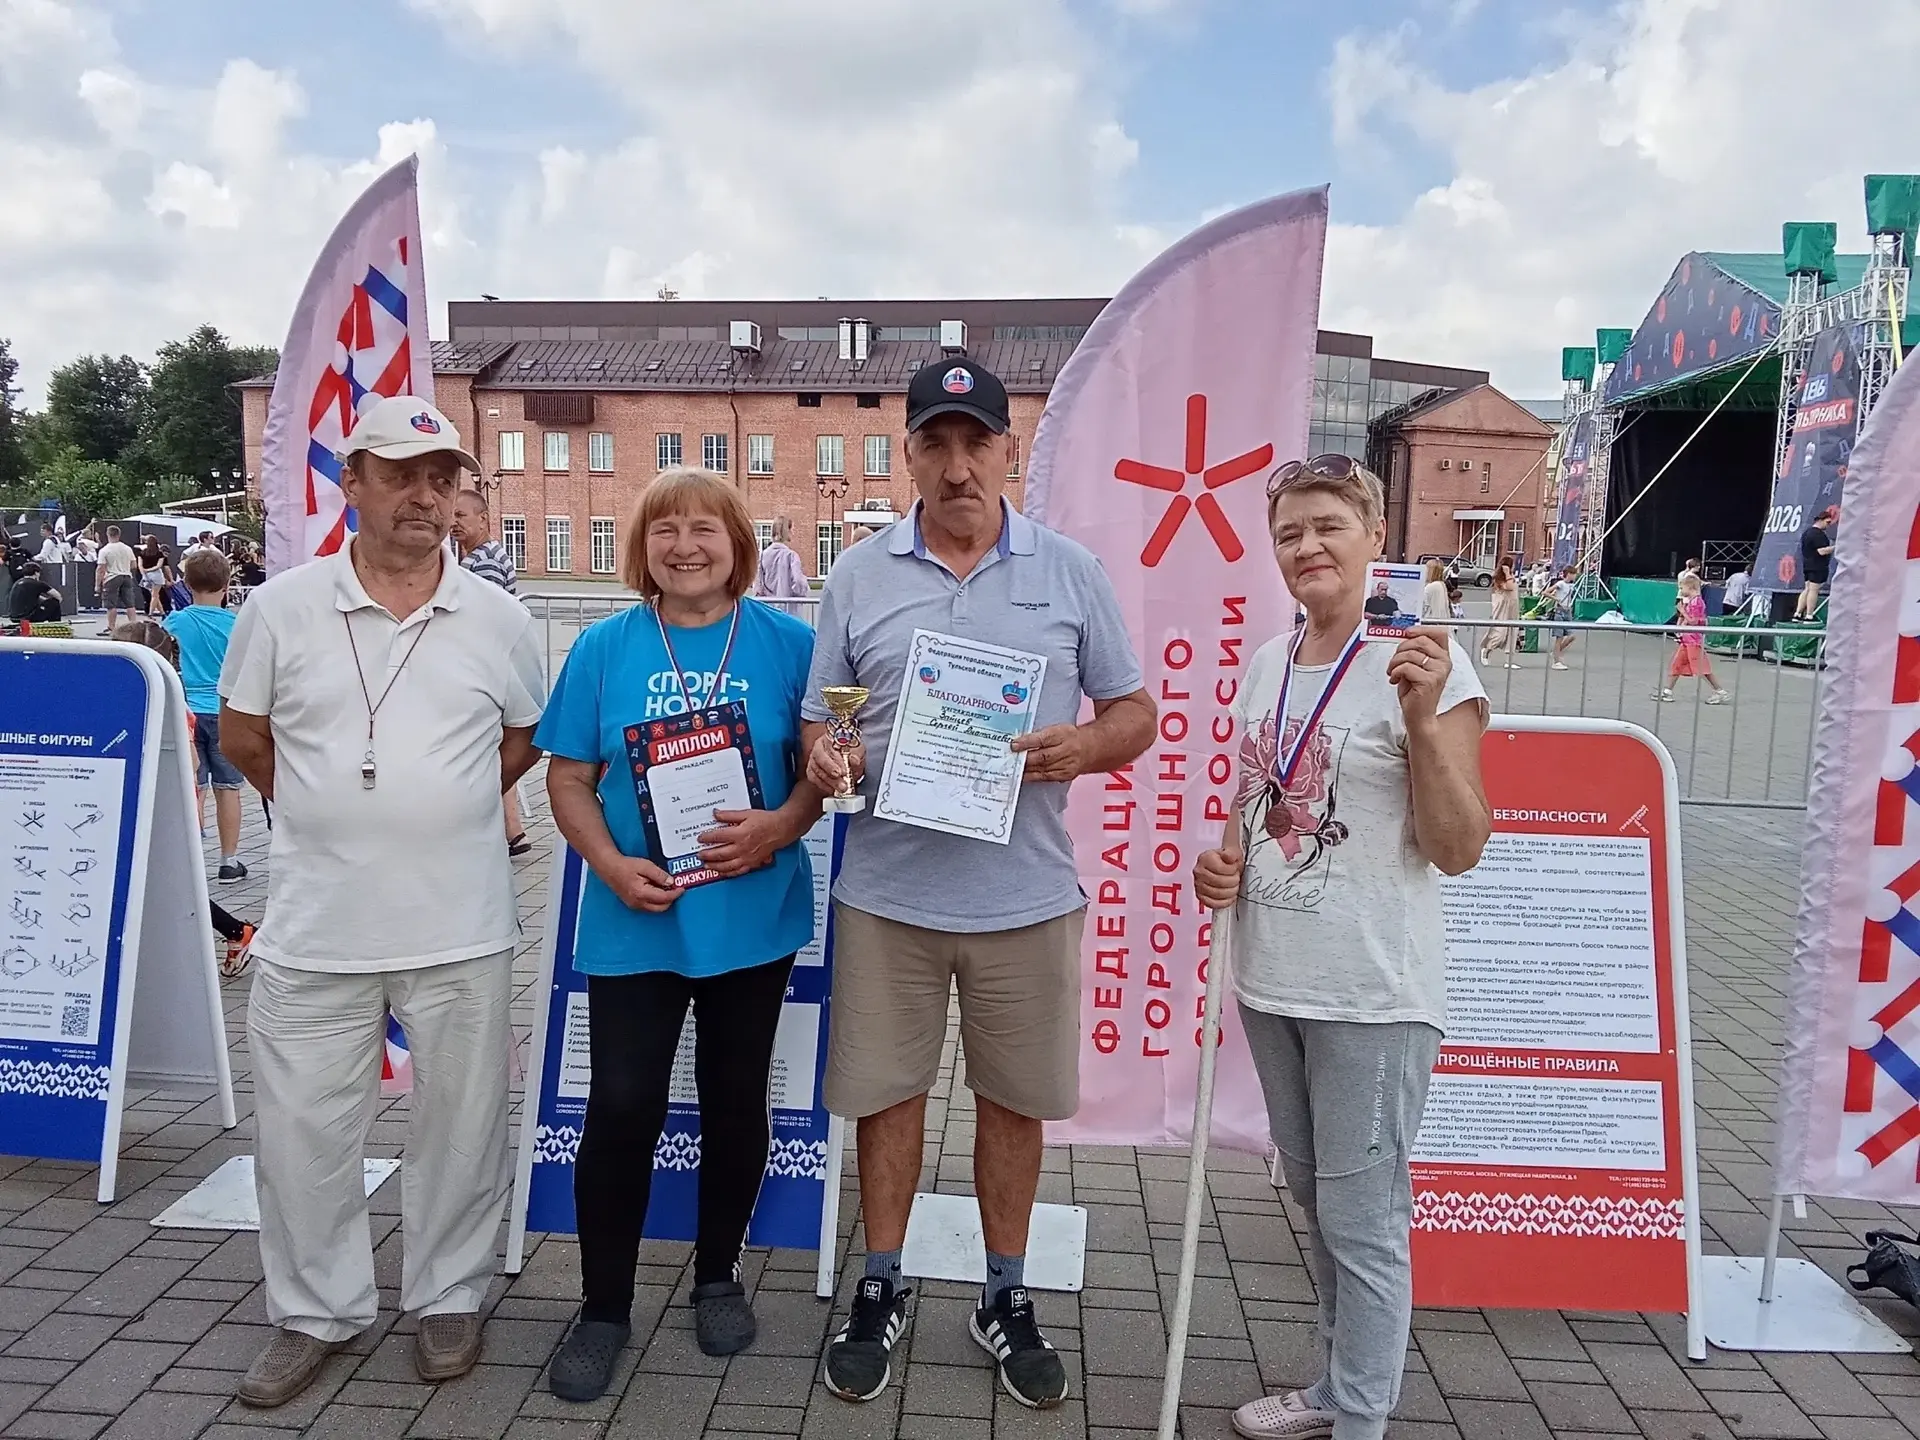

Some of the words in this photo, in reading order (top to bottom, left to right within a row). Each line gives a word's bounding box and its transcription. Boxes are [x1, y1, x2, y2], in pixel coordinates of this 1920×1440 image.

[1764, 504, 1802, 533] 2026
[928, 647, 962, 660] Федерация
[963, 656, 1004, 670] городошного
[948, 662, 976, 672] Тульской
[977, 668, 1002, 678] области
[648, 671, 732, 694] СПОРТ
[926, 688, 1010, 714] БЛАГОДАРНОСТЬ
[1204, 596, 1247, 822] РОССИИ
[38, 734, 94, 746] ФИГУРЫ
[656, 730, 726, 762] ДИПЛОМ
[706, 783, 729, 794] МЕСТО
[1493, 808, 1608, 824] БЕЗОПАСНОСТИ
[1142, 638, 1193, 1057] ГОРОДОШНОГО
[672, 856, 702, 874] ДЕНЬ
[1457, 884, 1498, 892] производить
[1498, 884, 1524, 893] бросок,
[1476, 902, 1502, 911] бросок,
[1602, 906, 1624, 914] чтобы
[1492, 920, 1520, 928] стороны
[1580, 941, 1604, 950] бросок
[1494, 957, 1520, 966] броска,
[1624, 962, 1649, 971] районе
[1456, 975, 1476, 984] фигур
[1619, 993, 1650, 1001] которых
[1562, 1011, 1600, 1019] наркотиков
[1476, 1035, 1499, 1043] правил
[1438, 1052, 1540, 1070] ПРОЩЁННЫЕ
[1544, 1057, 1620, 1072] ПРАВИЛА
[1437, 1082, 1482, 1090] соревнования
[1437, 1107, 1466, 1115] порядок
[1450, 1115, 1464, 1124] При
[1459, 1132, 1509, 1142] соревнований
[1561, 1136, 1580, 1144] биты
[1583, 1137, 1606, 1145] любой
[1598, 1146, 1616, 1154] биты
[1632, 1147, 1650, 1155] биты
